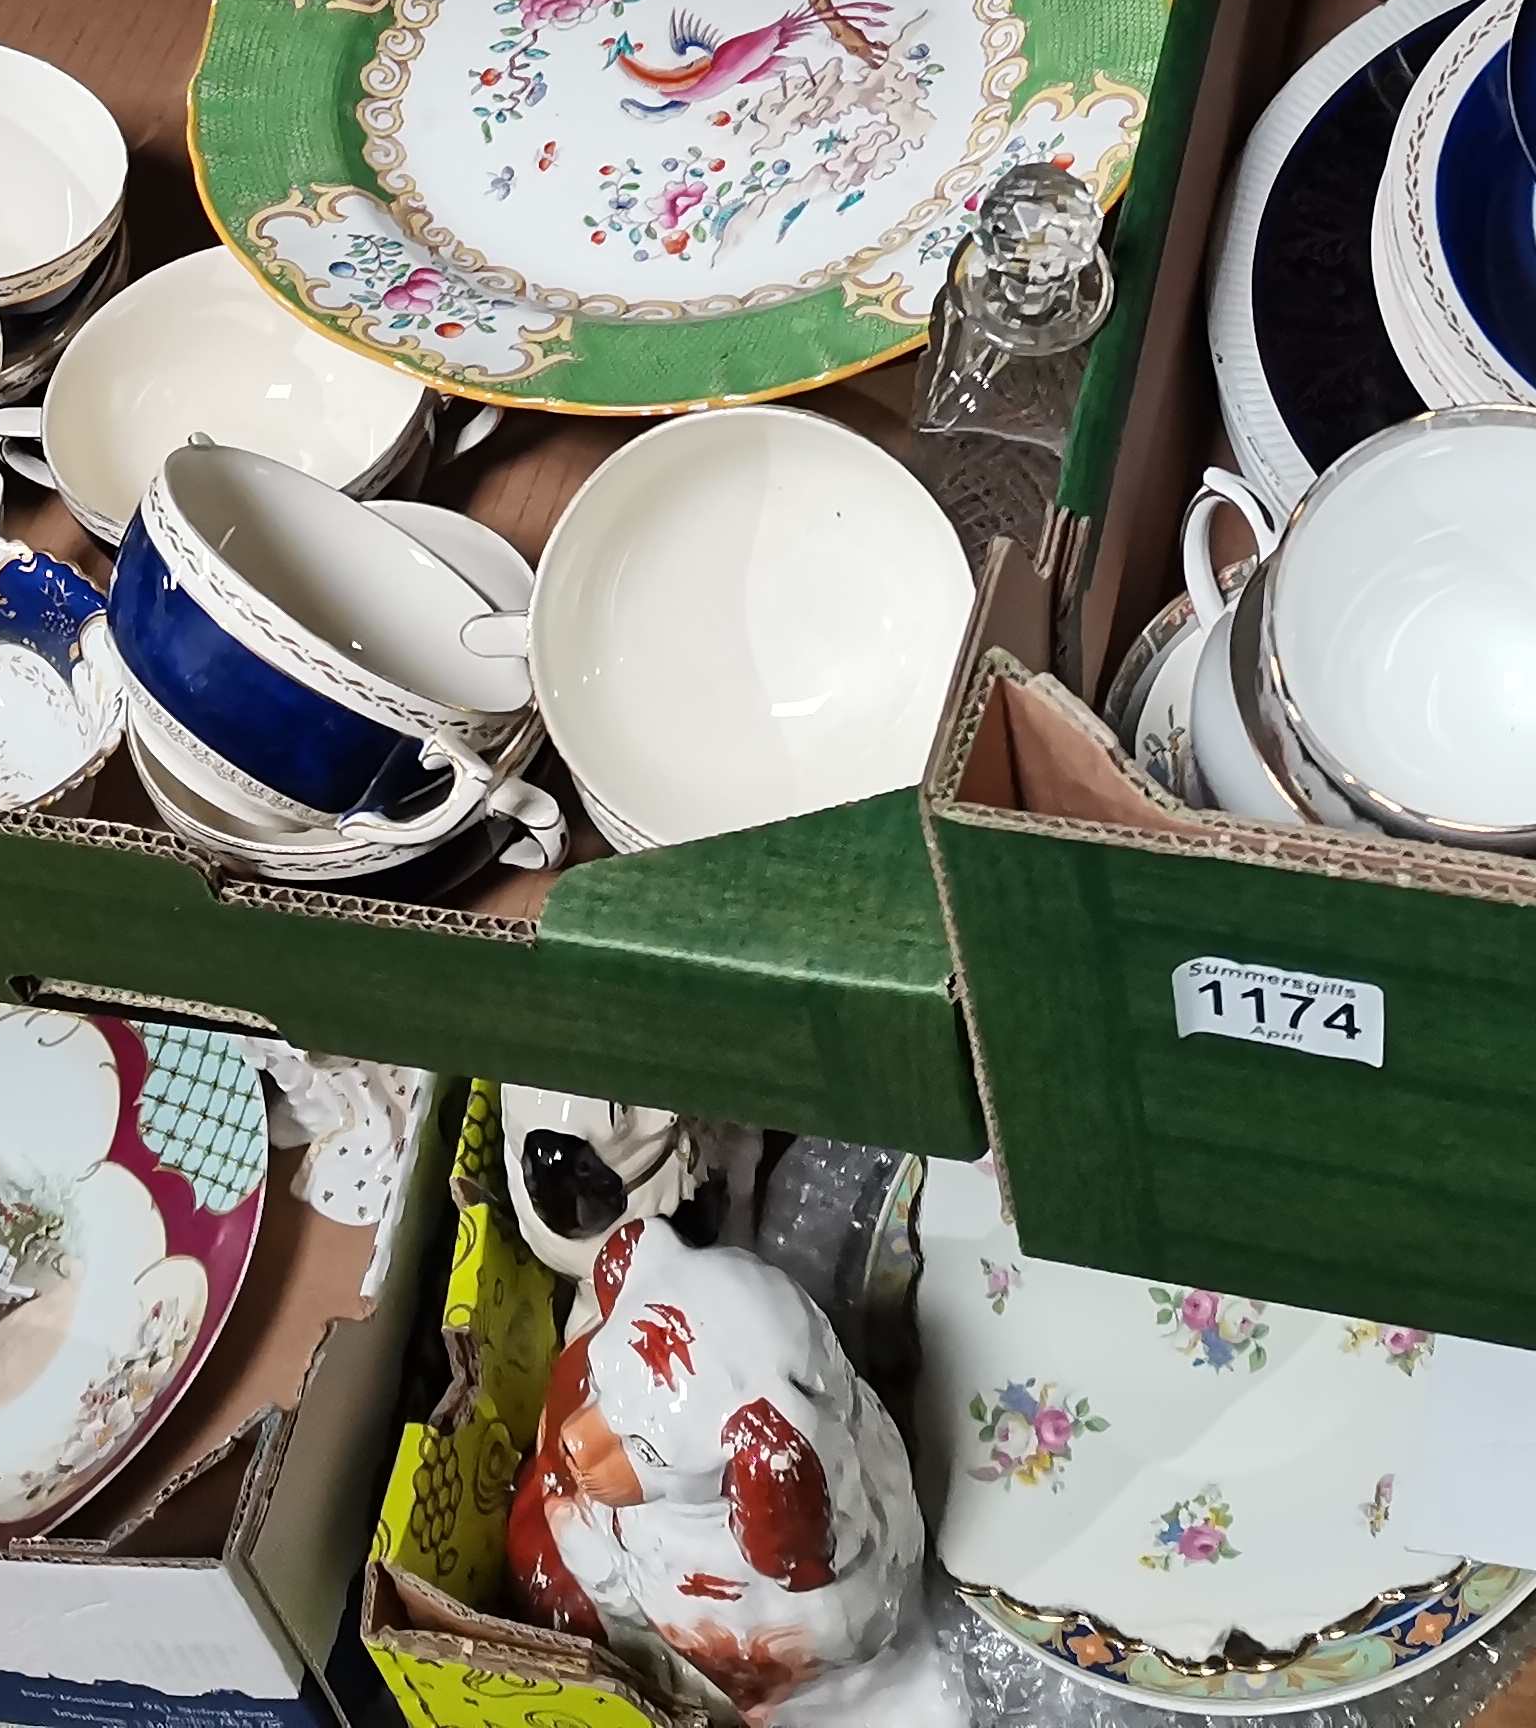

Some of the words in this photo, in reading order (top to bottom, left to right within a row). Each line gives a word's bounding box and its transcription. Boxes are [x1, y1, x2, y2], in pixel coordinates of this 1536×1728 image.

[1188, 961, 1357, 1000] Summersgills
[1197, 979, 1362, 1041] 1174
[1250, 1025, 1304, 1044] April
